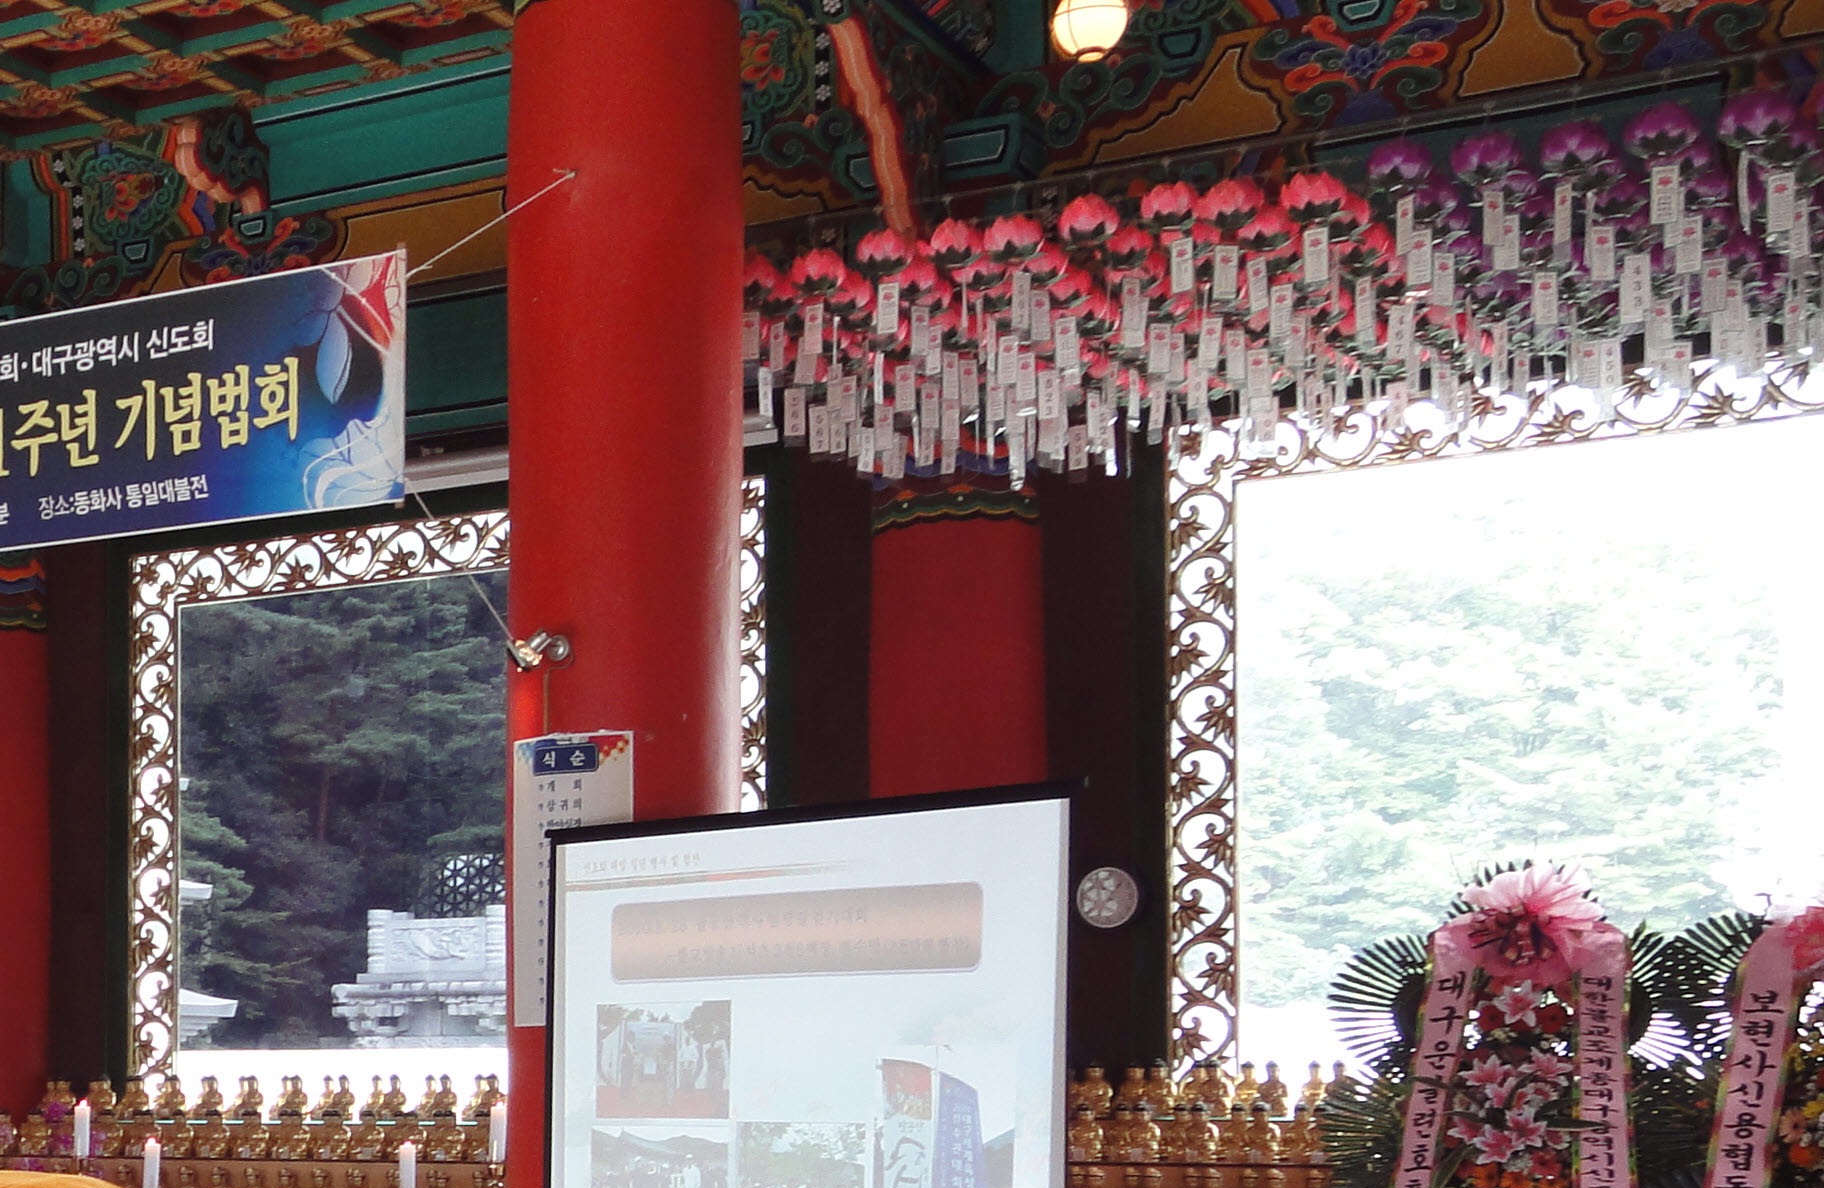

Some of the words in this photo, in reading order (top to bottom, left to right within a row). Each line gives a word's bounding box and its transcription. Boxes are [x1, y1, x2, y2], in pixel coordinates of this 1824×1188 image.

[146, 318, 216, 359] 신도회
[114, 356, 300, 461] 기념법회
[38, 486, 123, 520] 장소:동화사
[125, 474, 209, 508] 통일대불전
